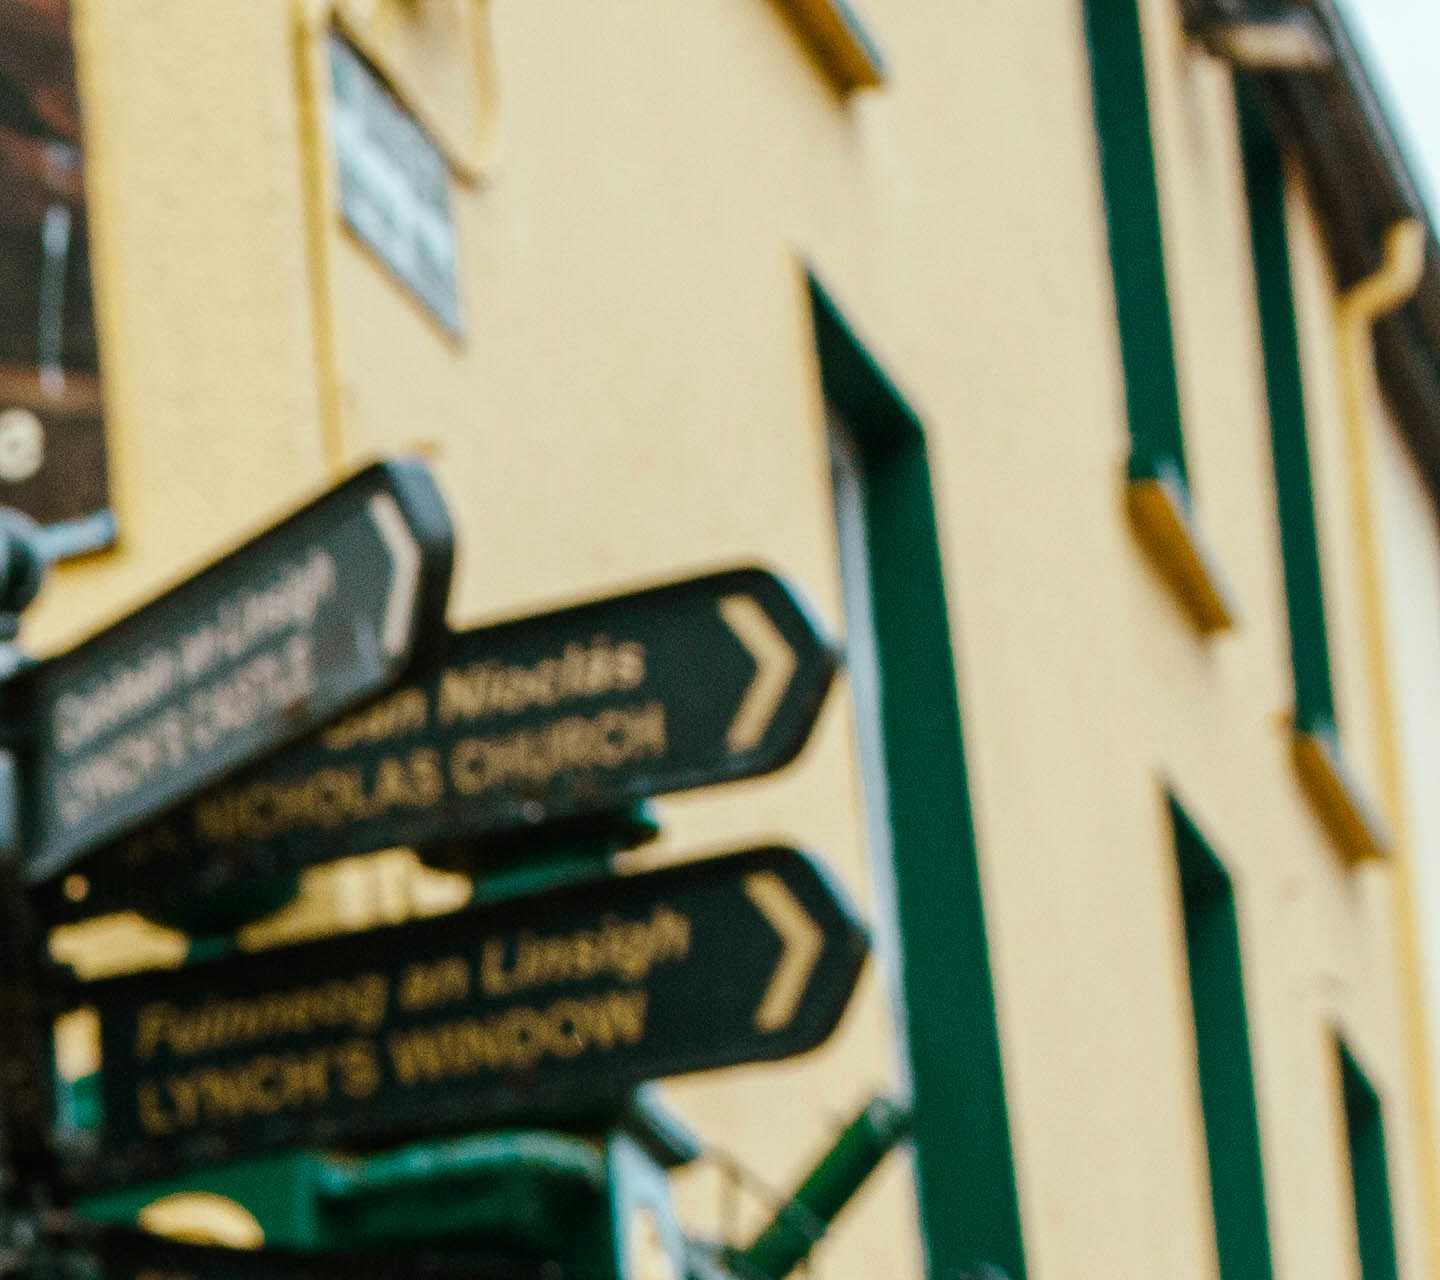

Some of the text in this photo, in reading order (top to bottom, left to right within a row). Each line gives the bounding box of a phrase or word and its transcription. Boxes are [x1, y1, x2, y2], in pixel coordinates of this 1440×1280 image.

[192, 698, 668, 843] NICHOLAS CHURCH
[398, 956, 472, 1011] an
[480, 903, 691, 997] Linsigh
[137, 986, 648, 1136] LYNCH'S WINDOW
